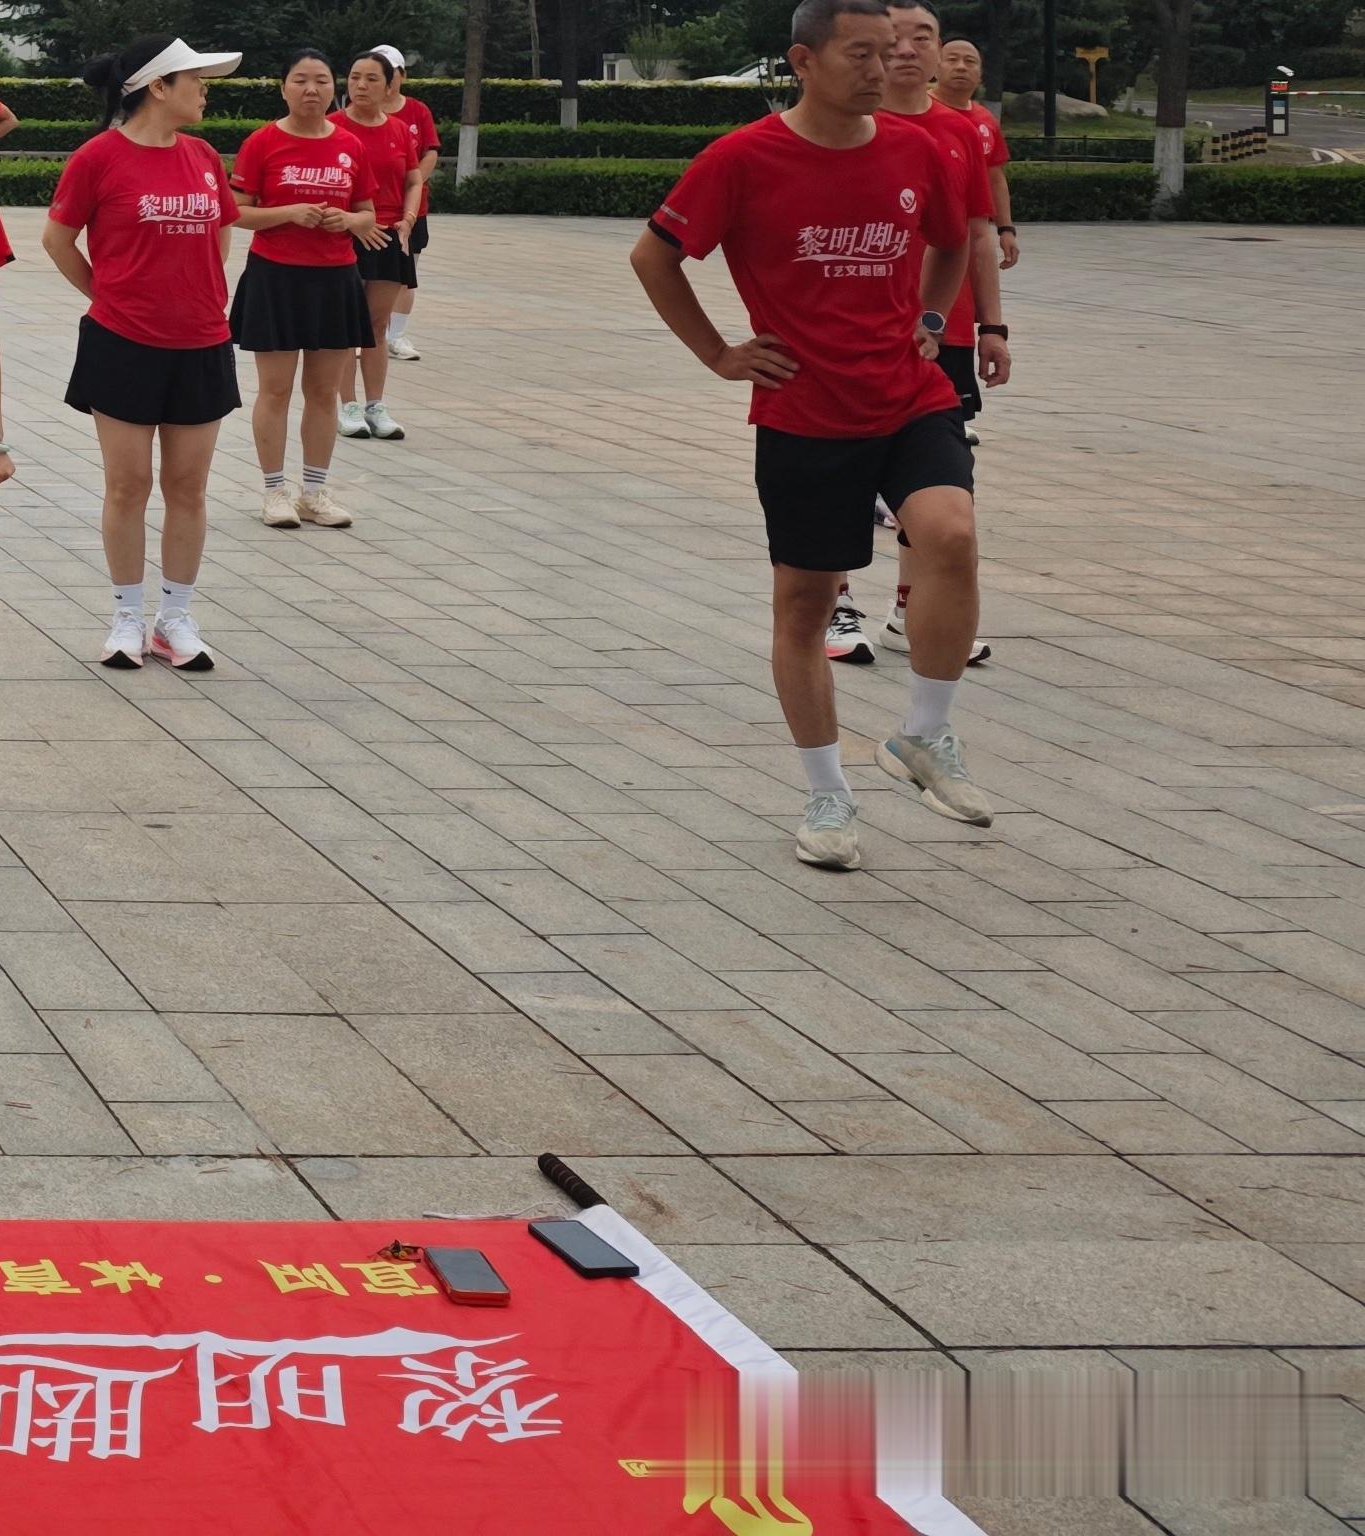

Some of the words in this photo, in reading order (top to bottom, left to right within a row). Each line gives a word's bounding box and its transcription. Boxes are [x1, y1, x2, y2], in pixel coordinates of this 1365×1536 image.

[137, 193, 221, 223] 黎明脚步
[791, 222, 910, 262] 黎明脚步
